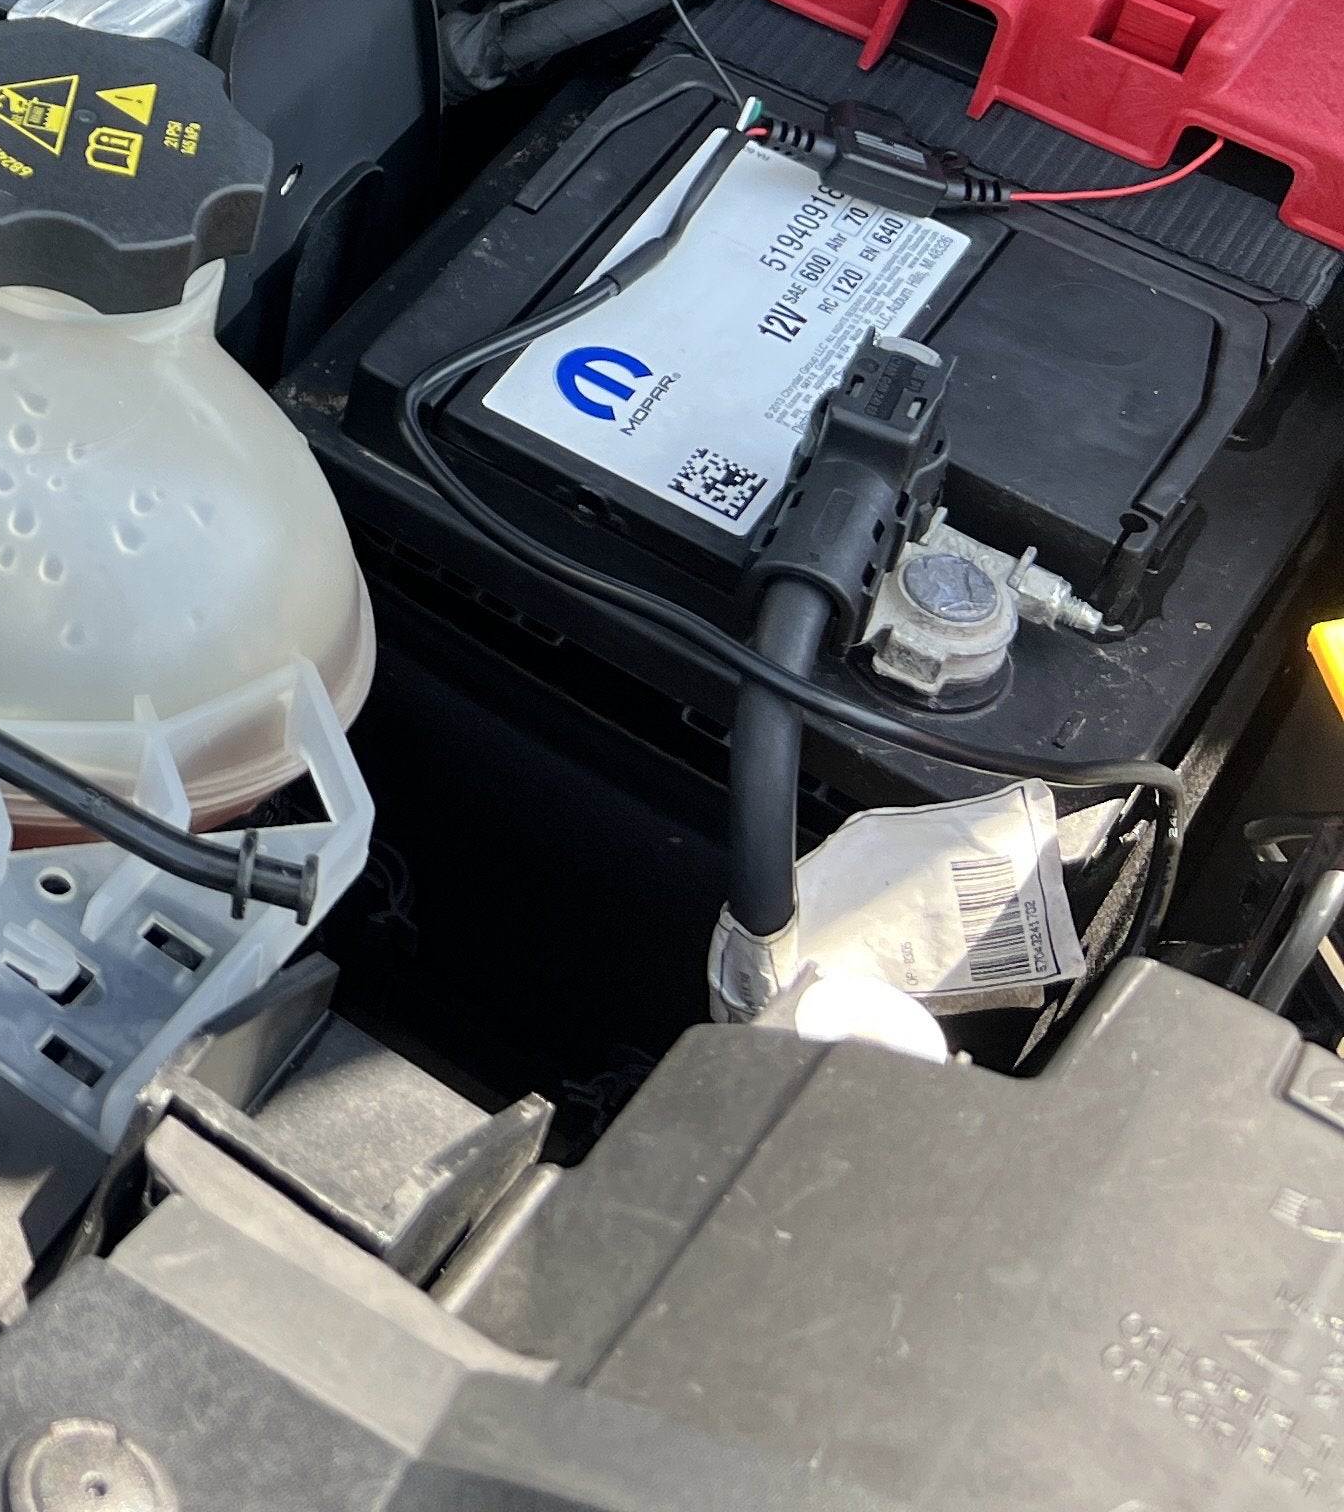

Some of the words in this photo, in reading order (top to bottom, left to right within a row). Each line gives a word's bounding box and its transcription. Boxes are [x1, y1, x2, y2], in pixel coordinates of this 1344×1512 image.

[165, 121, 182, 138] PSI
[163, 136, 179, 150] 21
[841, 206, 869, 226] 70
[825, 233, 847, 252] Ahr
[799, 254, 831, 282] 600
[816, 297, 839, 314] RC
[832, 268, 863, 296] 120
[858, 246, 880, 263] EN
[872, 217, 904, 245] 640
[781, 282, 807, 304] SAE
[757, 301, 807, 343] 12V
[619, 374, 676, 437] MOPAR
